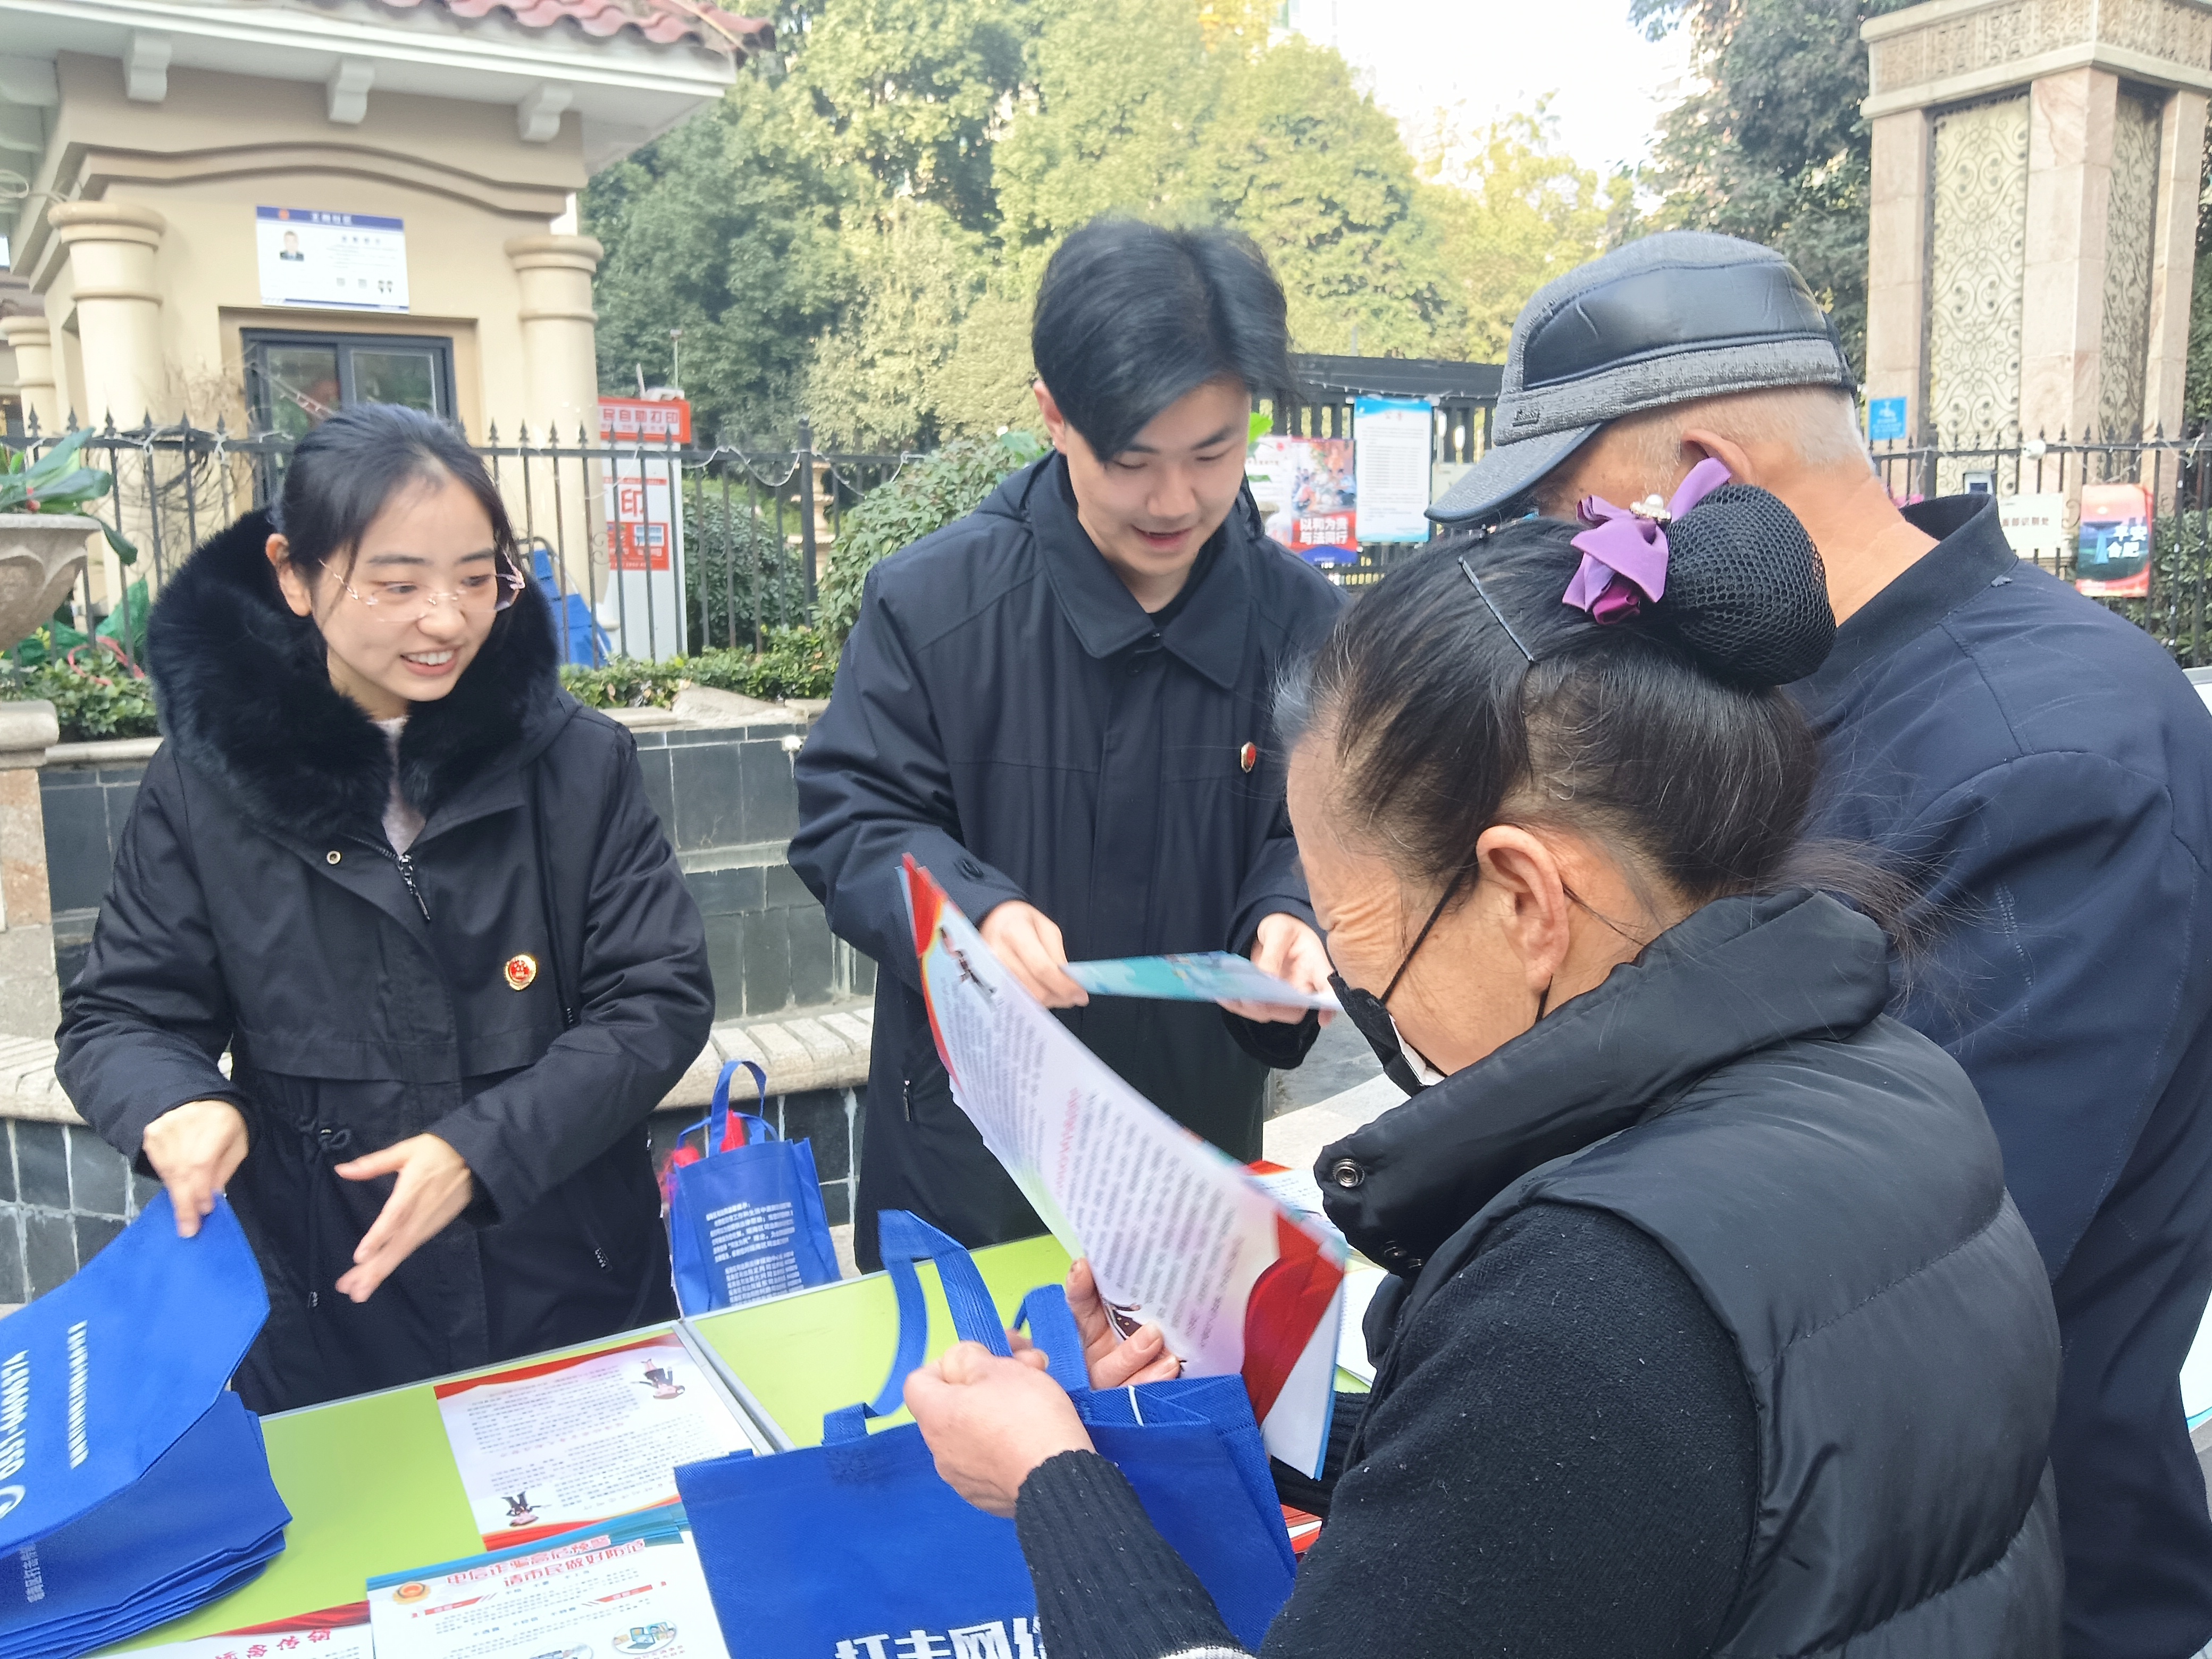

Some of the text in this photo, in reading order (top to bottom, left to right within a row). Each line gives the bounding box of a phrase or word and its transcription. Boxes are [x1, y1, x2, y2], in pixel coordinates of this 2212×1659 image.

[1300, 517, 1347, 531] 以和为贵
[1300, 531, 1347, 545] 与法同行
[2114, 525, 2147, 541] 平安
[2107, 541, 2139, 558] 合肥
